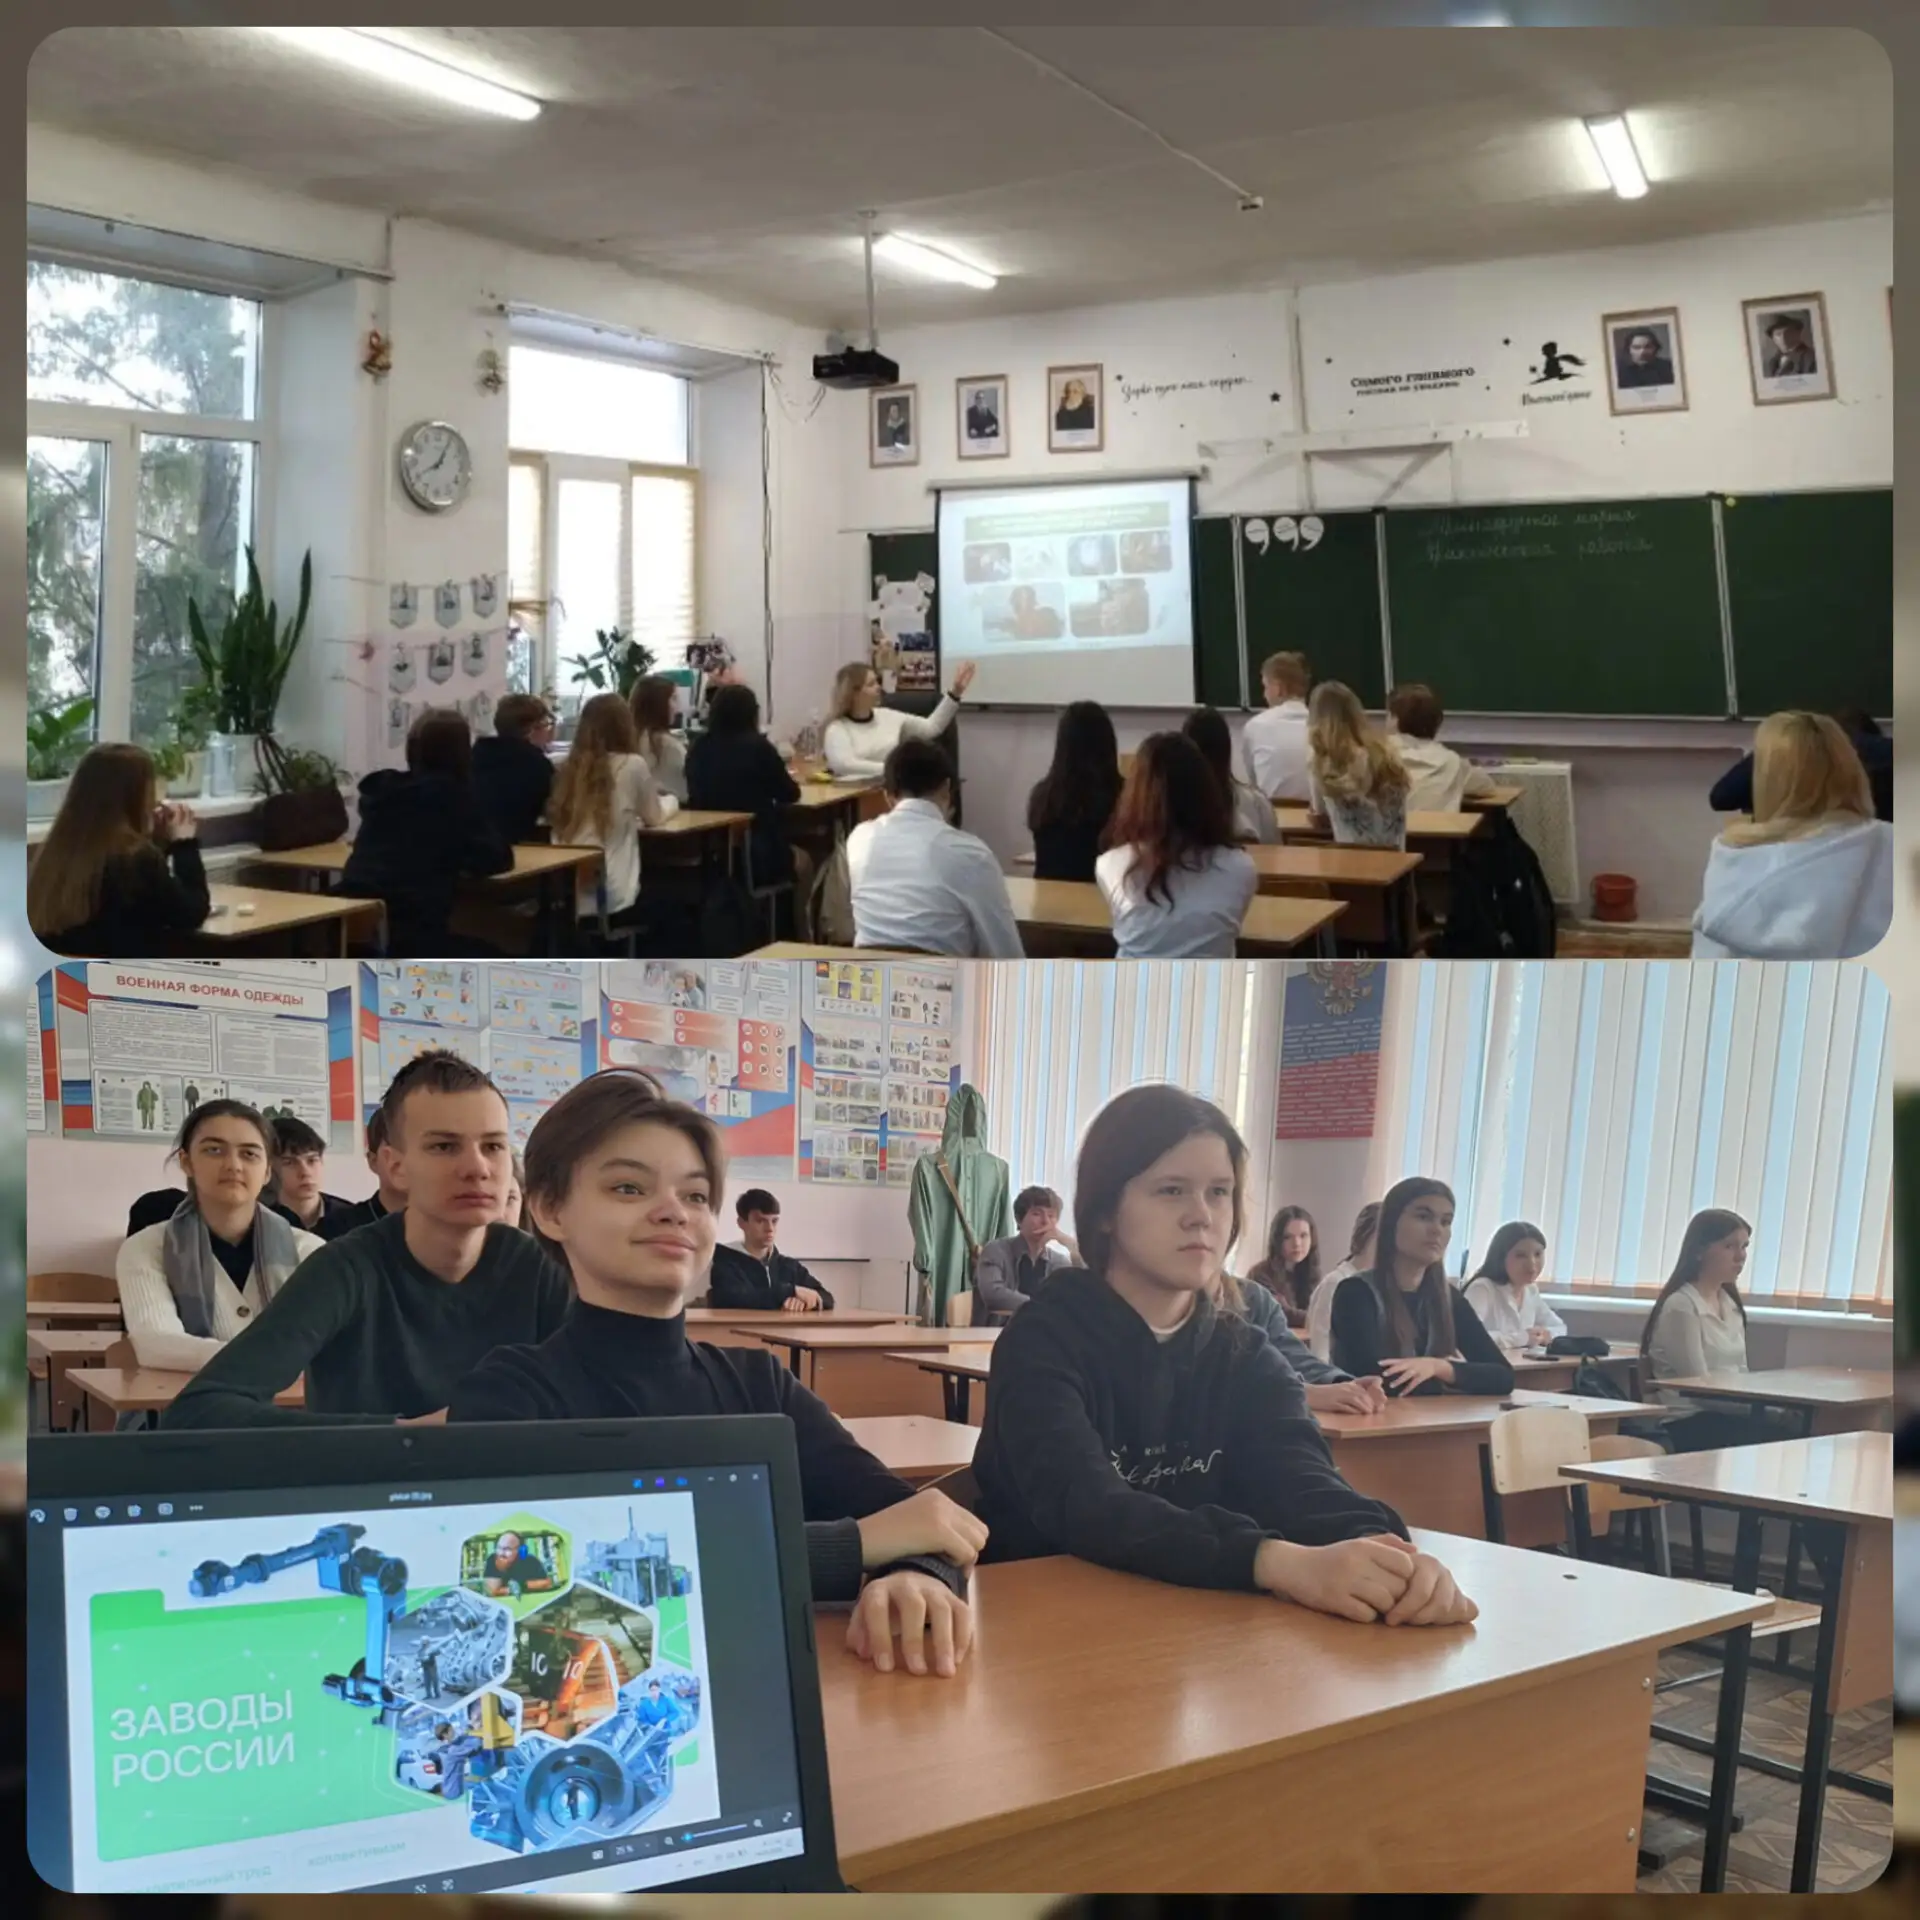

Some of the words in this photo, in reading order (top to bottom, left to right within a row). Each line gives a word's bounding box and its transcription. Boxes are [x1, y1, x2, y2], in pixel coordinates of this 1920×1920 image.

[116, 974, 186, 992] ВОЕННАЯ
[189, 983, 241, 999] ФОРМА
[244, 989, 304, 1006] ОДЕЖДЫ
[110, 1689, 294, 1741] ЗАВОДЫ
[112, 1732, 295, 1788] РОССИИ
